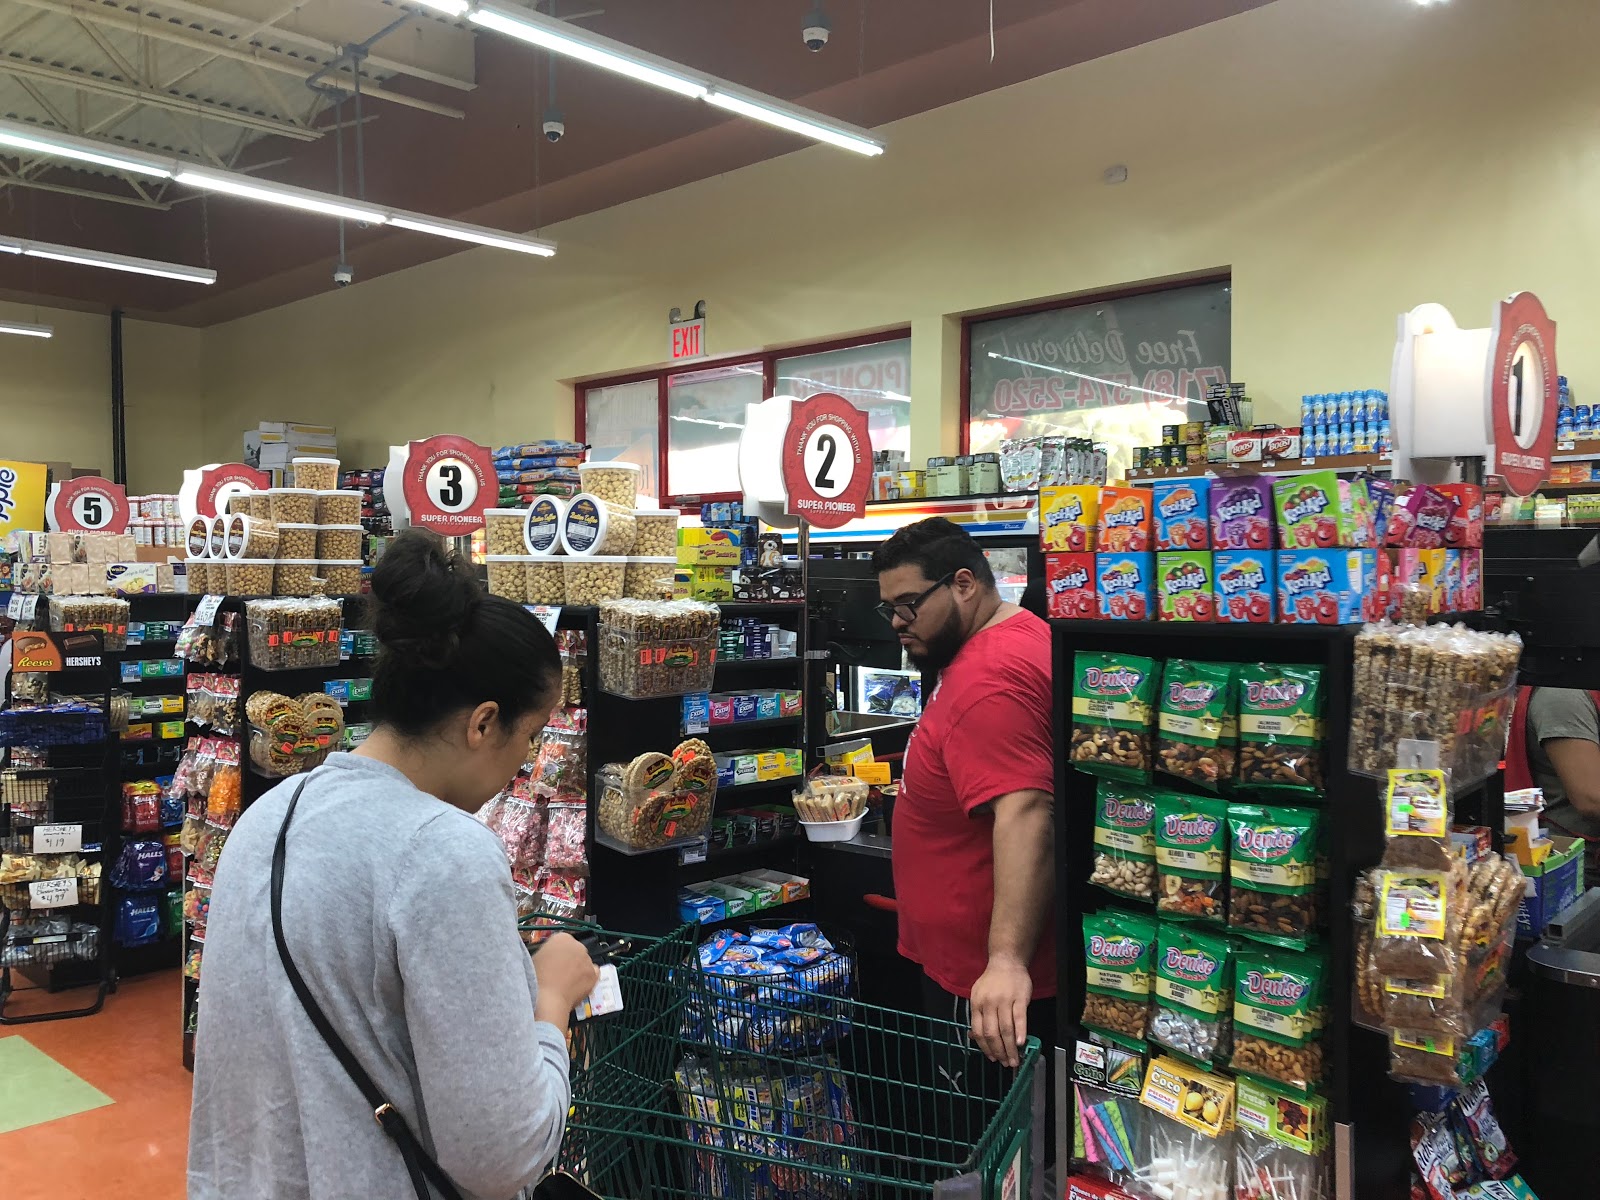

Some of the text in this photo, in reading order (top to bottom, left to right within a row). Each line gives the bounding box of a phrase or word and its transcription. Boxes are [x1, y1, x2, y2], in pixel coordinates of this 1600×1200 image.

[672, 325, 701, 359] EXIT
[1512, 355, 1524, 436] 1
[796, 413, 862, 464] THANK YOU FOR SHOPPING WITH US
[1232, 440, 1253, 454] BOOST
[1269, 437, 1292, 451] BOOST
[417, 449, 486, 487] THANK YOU FOR SHOPPING WITH US
[815, 433, 837, 489] 2
[208, 487, 217, 503] THANK
[215, 479, 224, 487] YOU
[439, 465, 463, 507] 3
[83, 496, 102, 525] 5
[797, 499, 856, 512] SUPER PIONEER
[421, 514, 483, 524] SUPER PIONEER
[66, 656, 102, 667] HERSHEY'S
[1085, 667, 1140, 688] Denise
[1169, 682, 1213, 703] Denise
[1247, 680, 1304, 702] Denise
[1105, 798, 1155, 820] Denise
[1165, 814, 1216, 837] Denise
[1239, 827, 1296, 849] Denise
[137, 851, 163, 860] HALLS
[130, 906, 156, 916] HALLS
[1090, 935, 1140, 959] Denise
[1100, 956, 1135, 966] Snacks
[1167, 947, 1214, 974] Denise
[1247, 971, 1304, 999] Denise
[1259, 994, 1296, 1006] Snacks
[1074, 1062, 1105, 1081] Gofio
[1151, 1071, 1182, 1093] Coco
